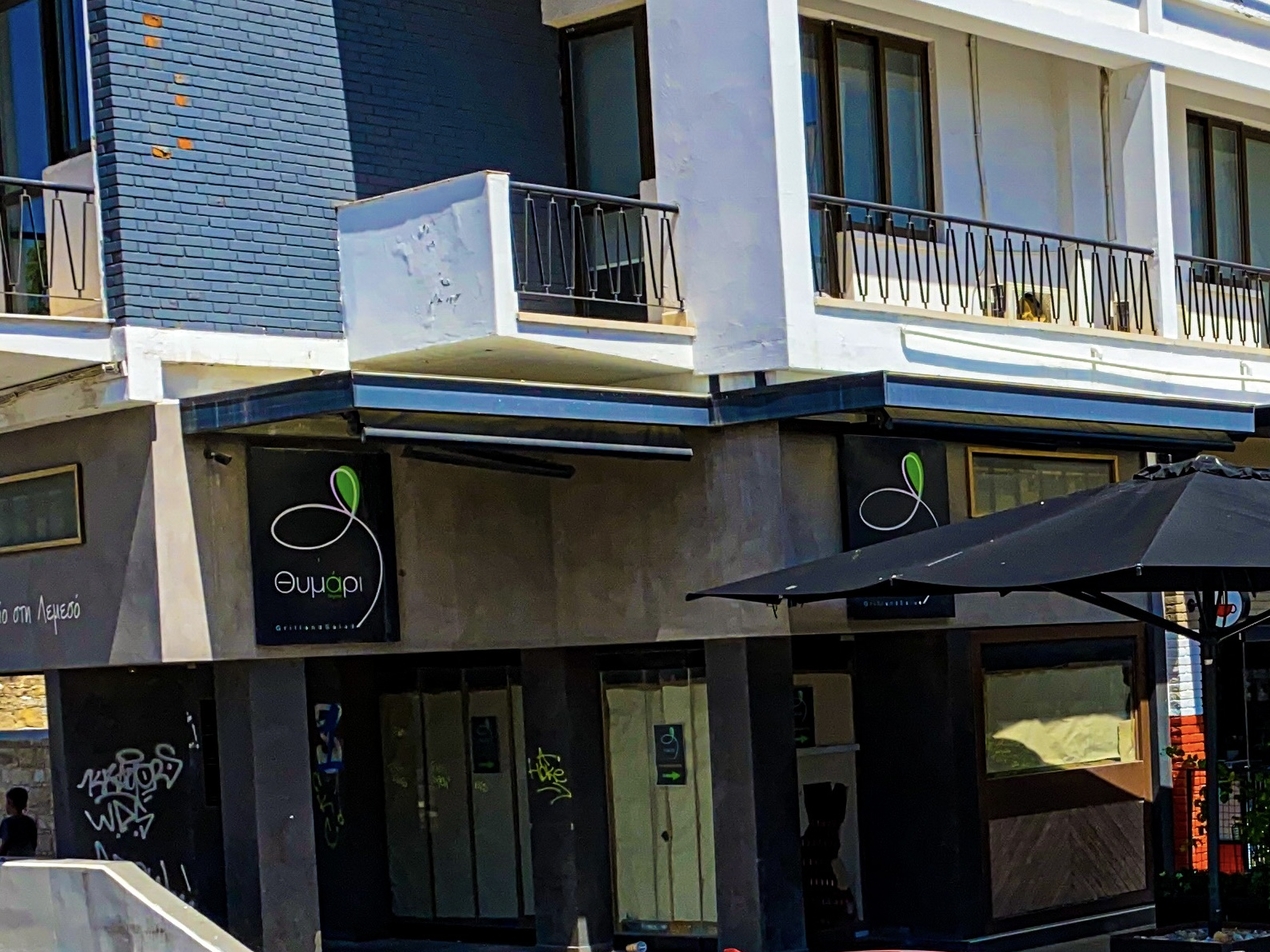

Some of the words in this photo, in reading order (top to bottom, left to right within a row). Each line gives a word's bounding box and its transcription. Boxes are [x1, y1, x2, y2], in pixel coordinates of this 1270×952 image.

[274, 570, 363, 599] Θυμάρι
[13, 605, 32, 624] στη
[37, 594, 81, 635] Λεμεσό
